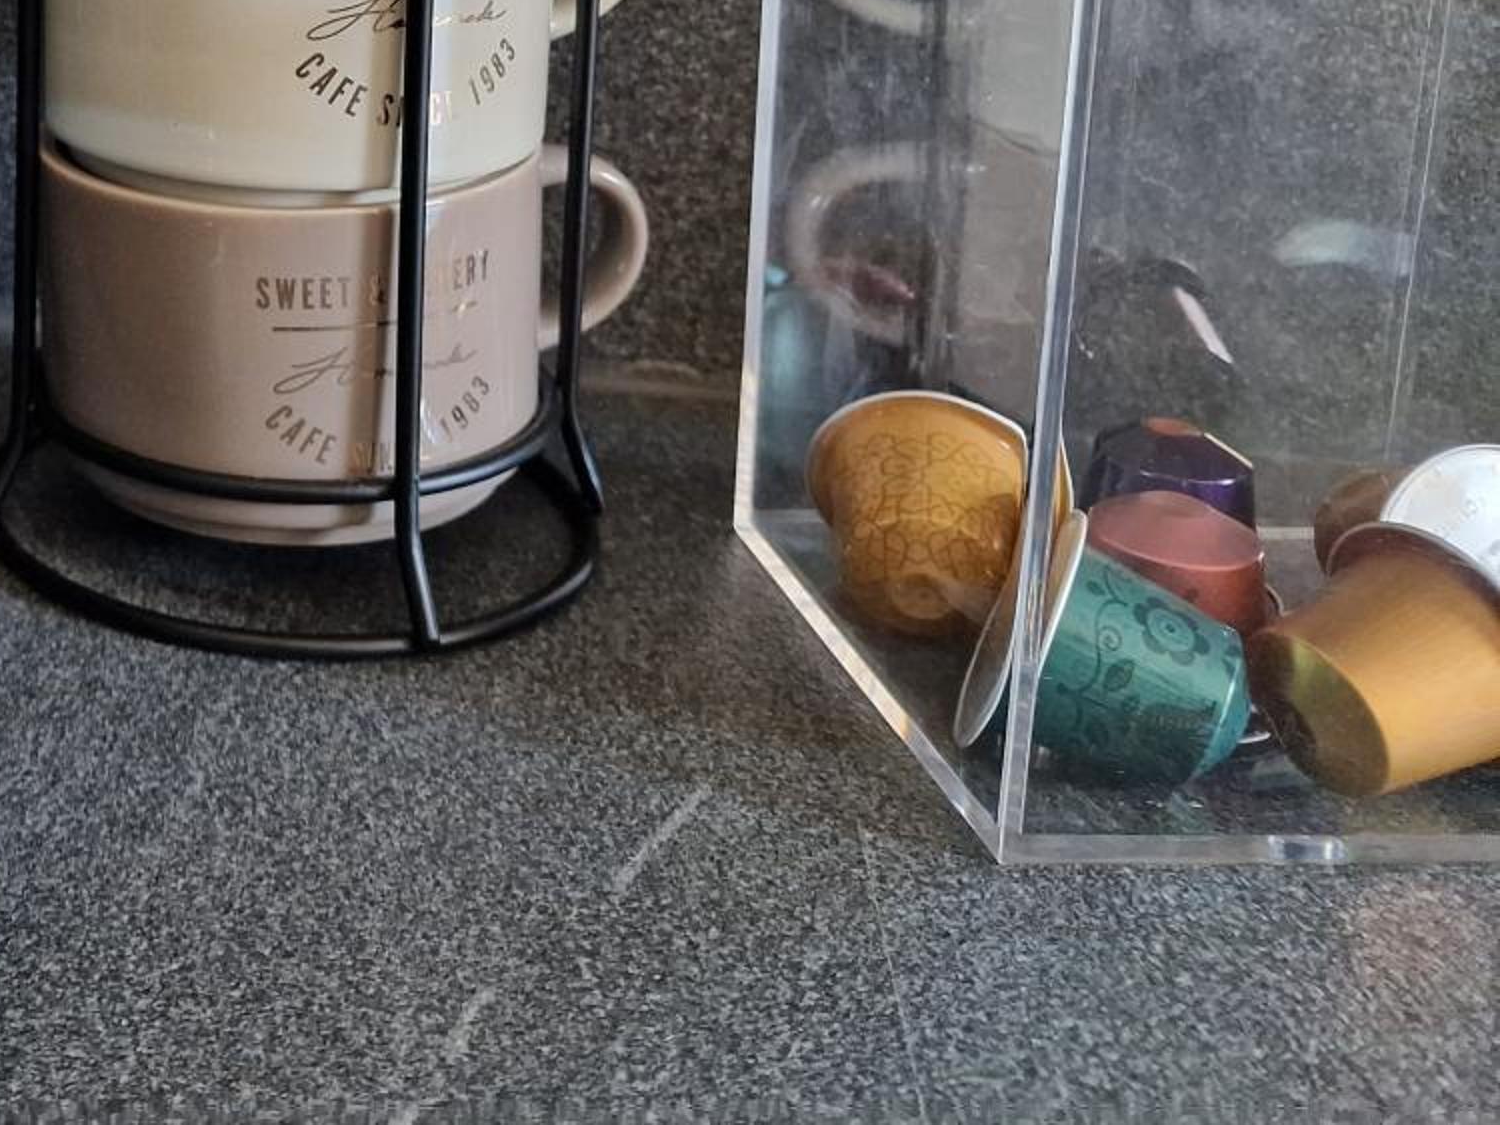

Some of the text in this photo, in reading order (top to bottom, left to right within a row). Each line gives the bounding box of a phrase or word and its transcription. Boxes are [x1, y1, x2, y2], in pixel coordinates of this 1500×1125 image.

[295, 52, 368, 117] CAFE
[468, 37, 516, 105] 1983
[256, 277, 350, 310] SWEET
[265, 405, 337, 465] CAFE
[440, 376, 490, 438] 1983
